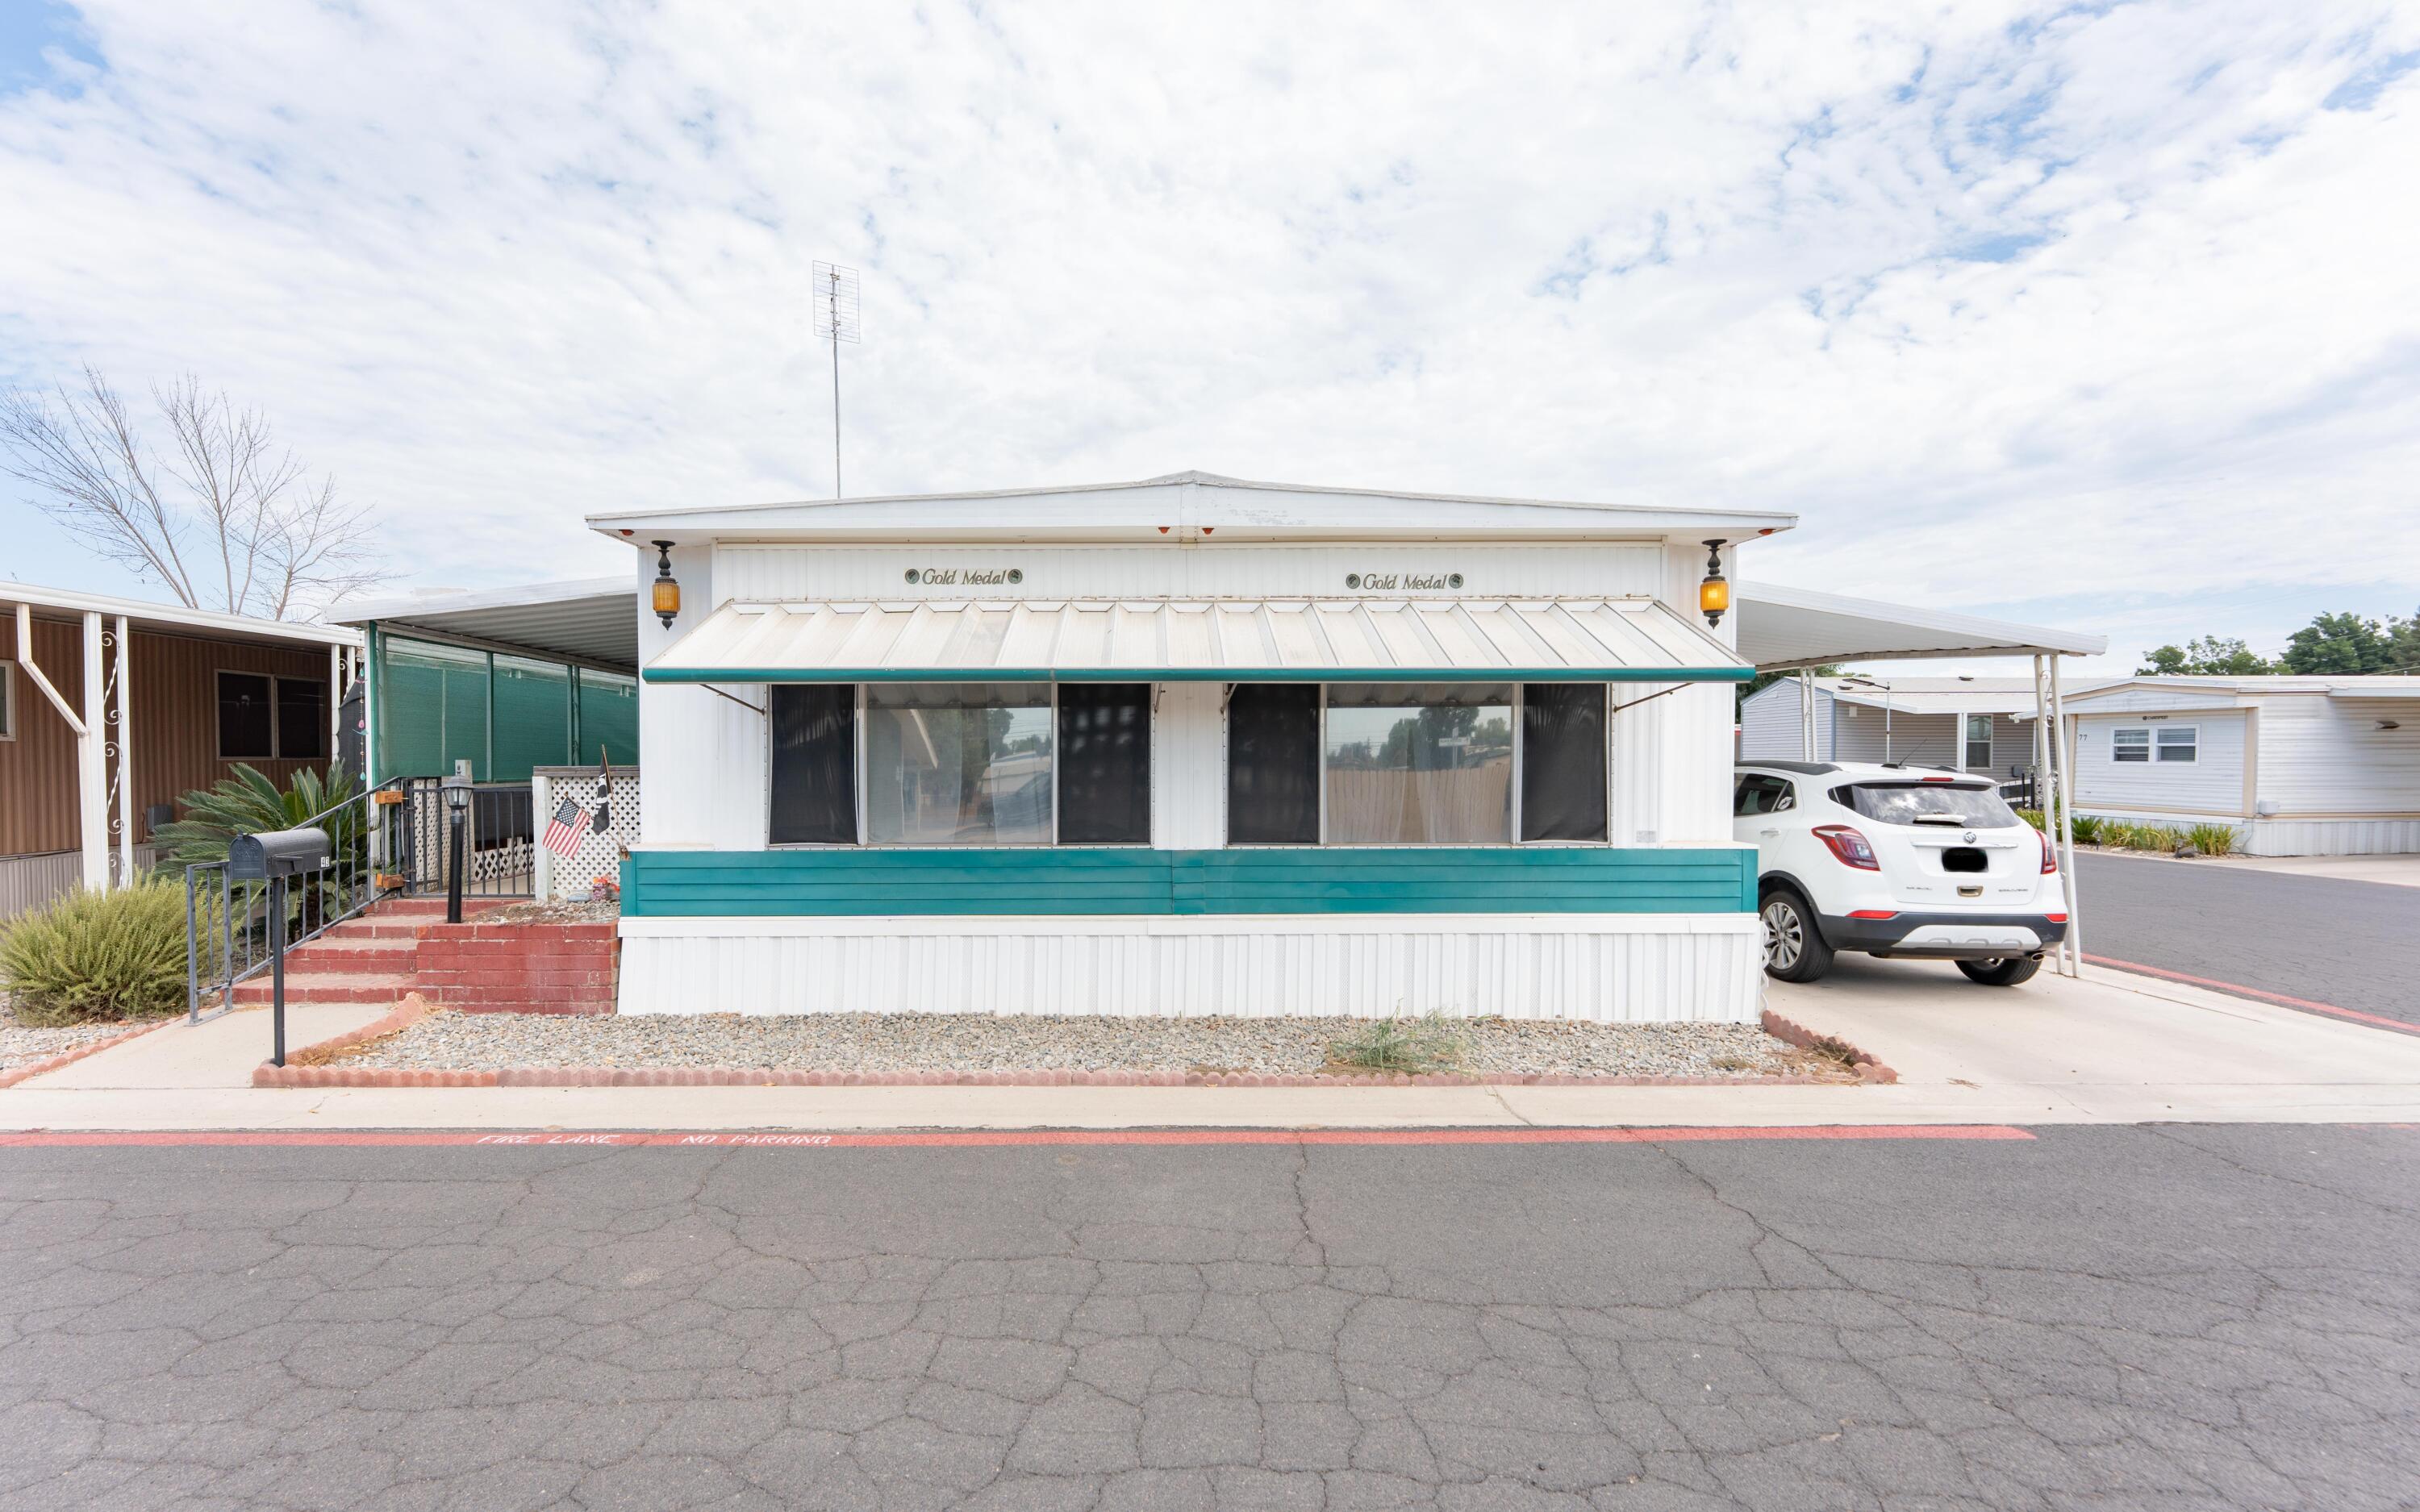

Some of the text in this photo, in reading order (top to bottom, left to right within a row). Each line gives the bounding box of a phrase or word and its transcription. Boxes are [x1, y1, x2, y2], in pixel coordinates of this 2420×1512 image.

[922, 569, 1007, 585] Gold Medal
[1362, 573, 1448, 590] Gold Medal
[476, 1135, 541, 1144] FIRE
[680, 1135, 718, 1144] NO
[729, 1135, 832, 1144] PARKING
